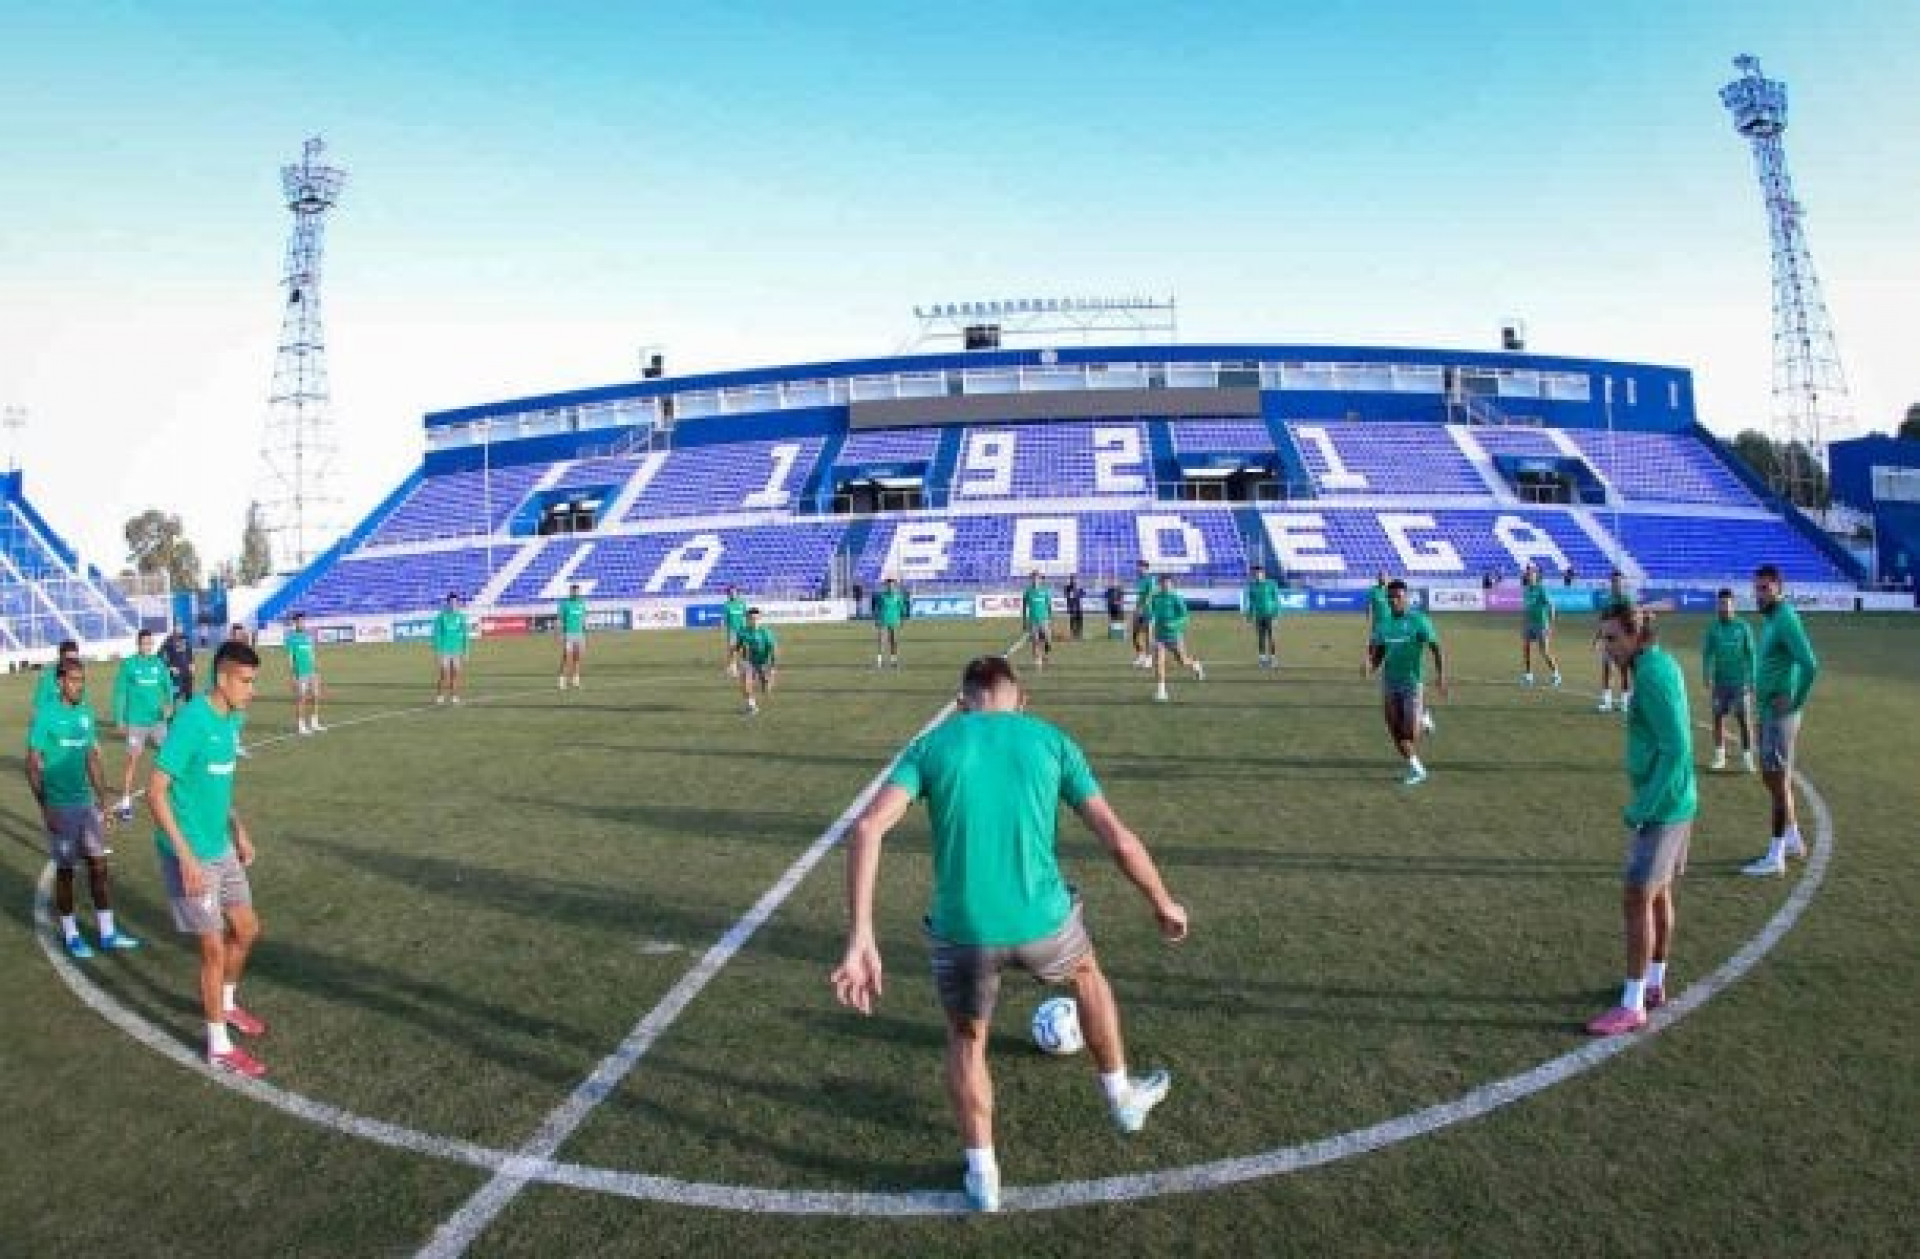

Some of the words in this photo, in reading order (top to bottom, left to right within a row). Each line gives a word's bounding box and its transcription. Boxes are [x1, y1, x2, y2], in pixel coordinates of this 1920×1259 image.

[742, 428, 1368, 507] 1921
[538, 534, 726, 599] LA
[880, 513, 1571, 580] BODEGA
